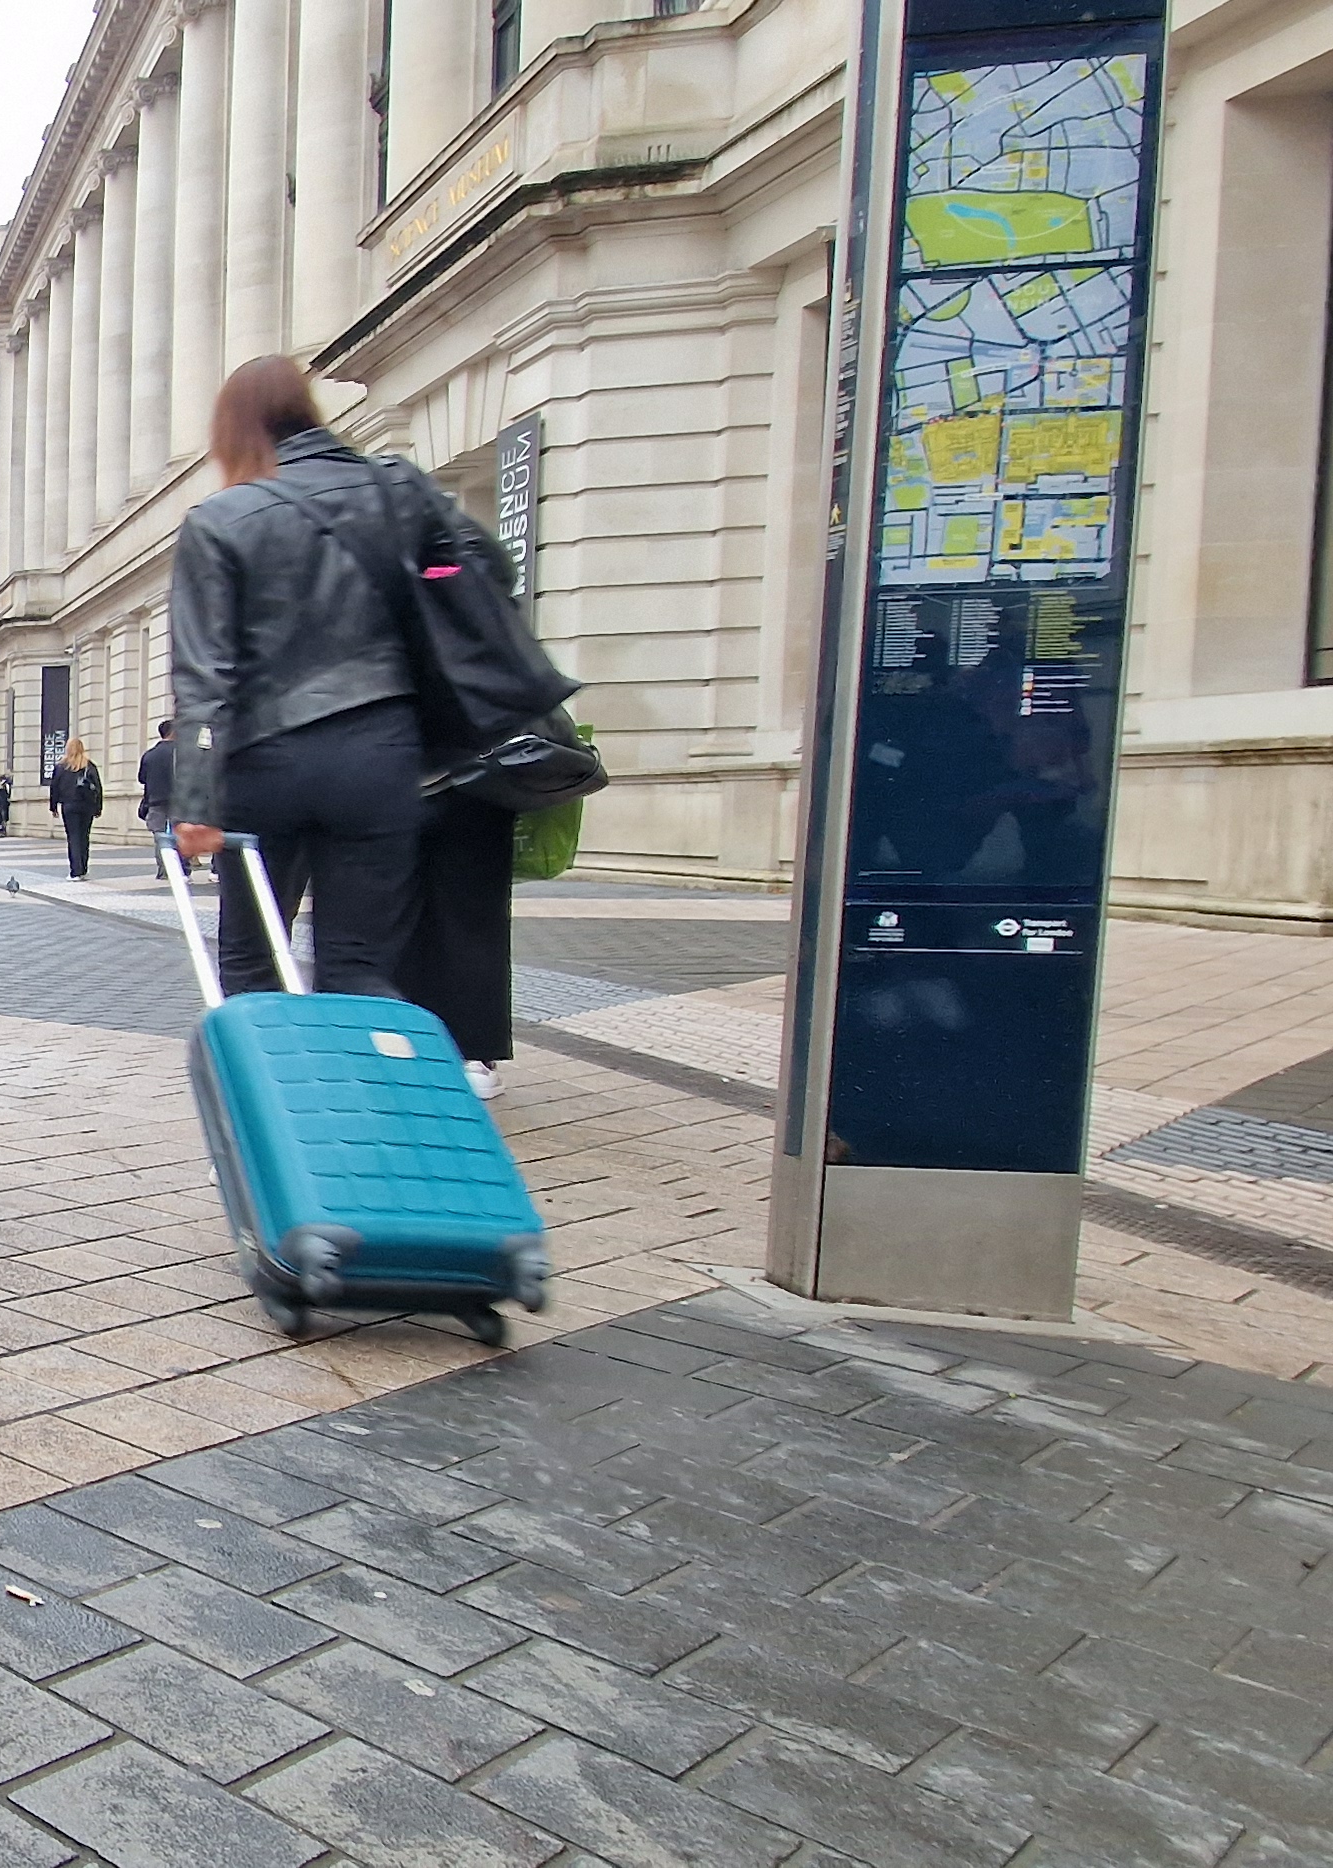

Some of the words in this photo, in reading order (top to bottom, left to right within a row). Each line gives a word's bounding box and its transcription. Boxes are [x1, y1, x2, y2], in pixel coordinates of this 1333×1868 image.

[448, 132, 510, 206] MUSEUM
[498, 447, 517, 550] ENCE
[44, 733, 54, 779] SCIENCE
[54, 730, 66, 765] SEUM
